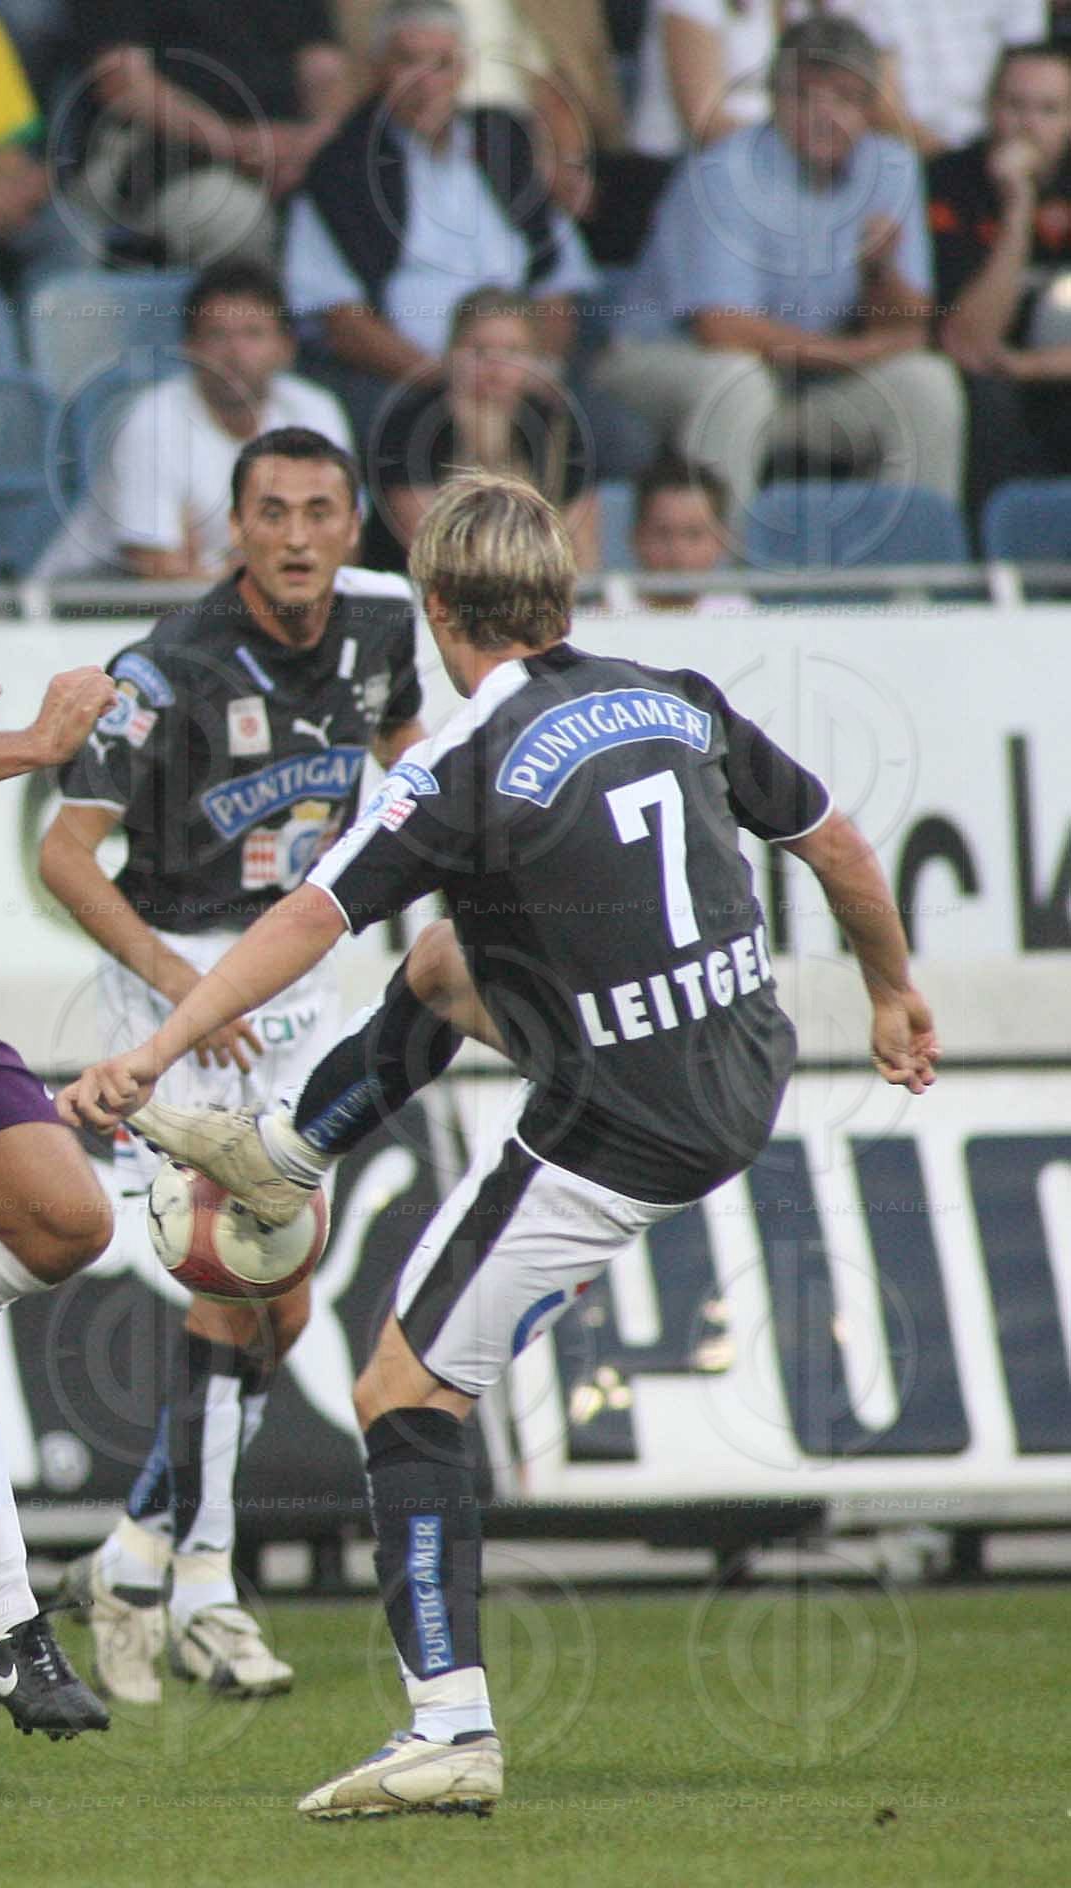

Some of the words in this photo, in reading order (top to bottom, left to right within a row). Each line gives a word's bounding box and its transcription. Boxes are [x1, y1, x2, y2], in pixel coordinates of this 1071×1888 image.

[214, 751, 365, 828] PUNTIGA
[510, 697, 704, 794] PUNTIGAMER
[605, 769, 701, 950] 7
[415, 1521, 449, 1671] PUNTIGAMER
